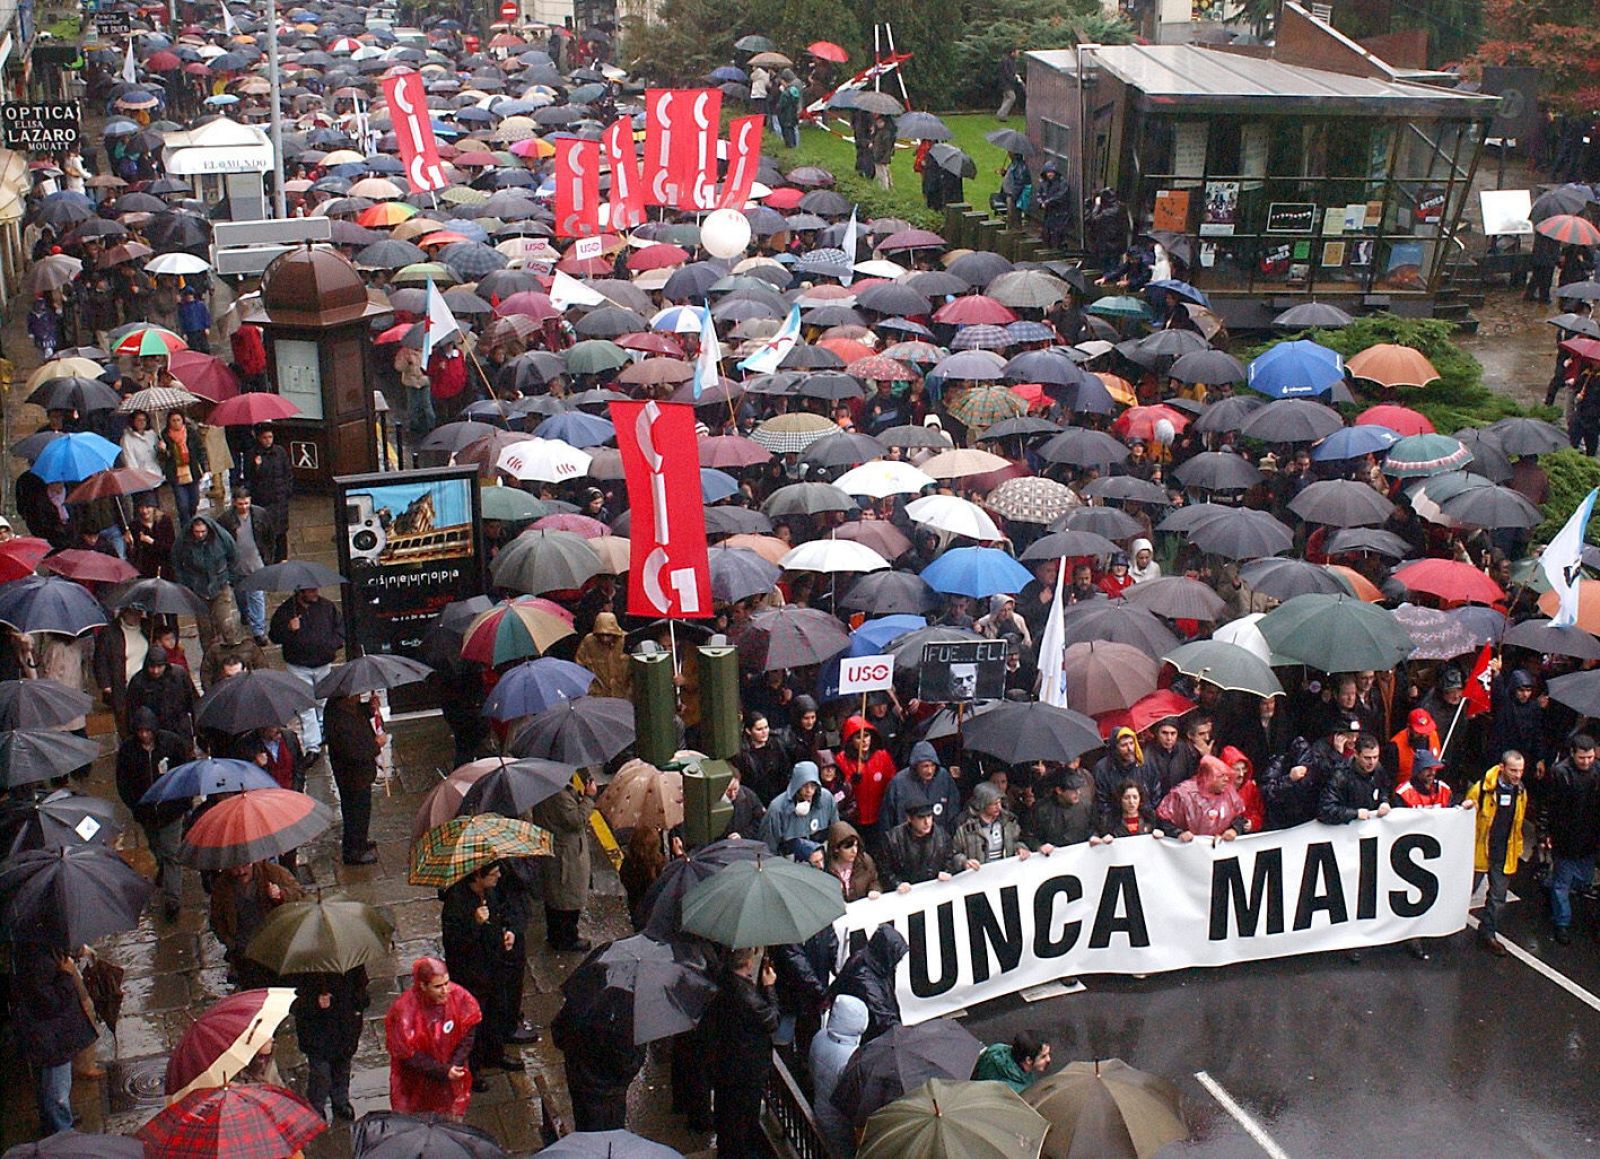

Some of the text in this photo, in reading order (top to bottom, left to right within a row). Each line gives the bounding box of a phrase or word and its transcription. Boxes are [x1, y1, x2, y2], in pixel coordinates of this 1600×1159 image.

[6, 106, 75, 120] OPTICA
[14, 121, 44, 129] ELISA
[8, 128, 76, 142] LAZARO
[525, 242, 545, 251] USO
[580, 242, 600, 253] USO
[527, 261, 549, 273] USO
[848, 664, 889, 683] USO
[1208, 833, 1442, 941] MAIS
